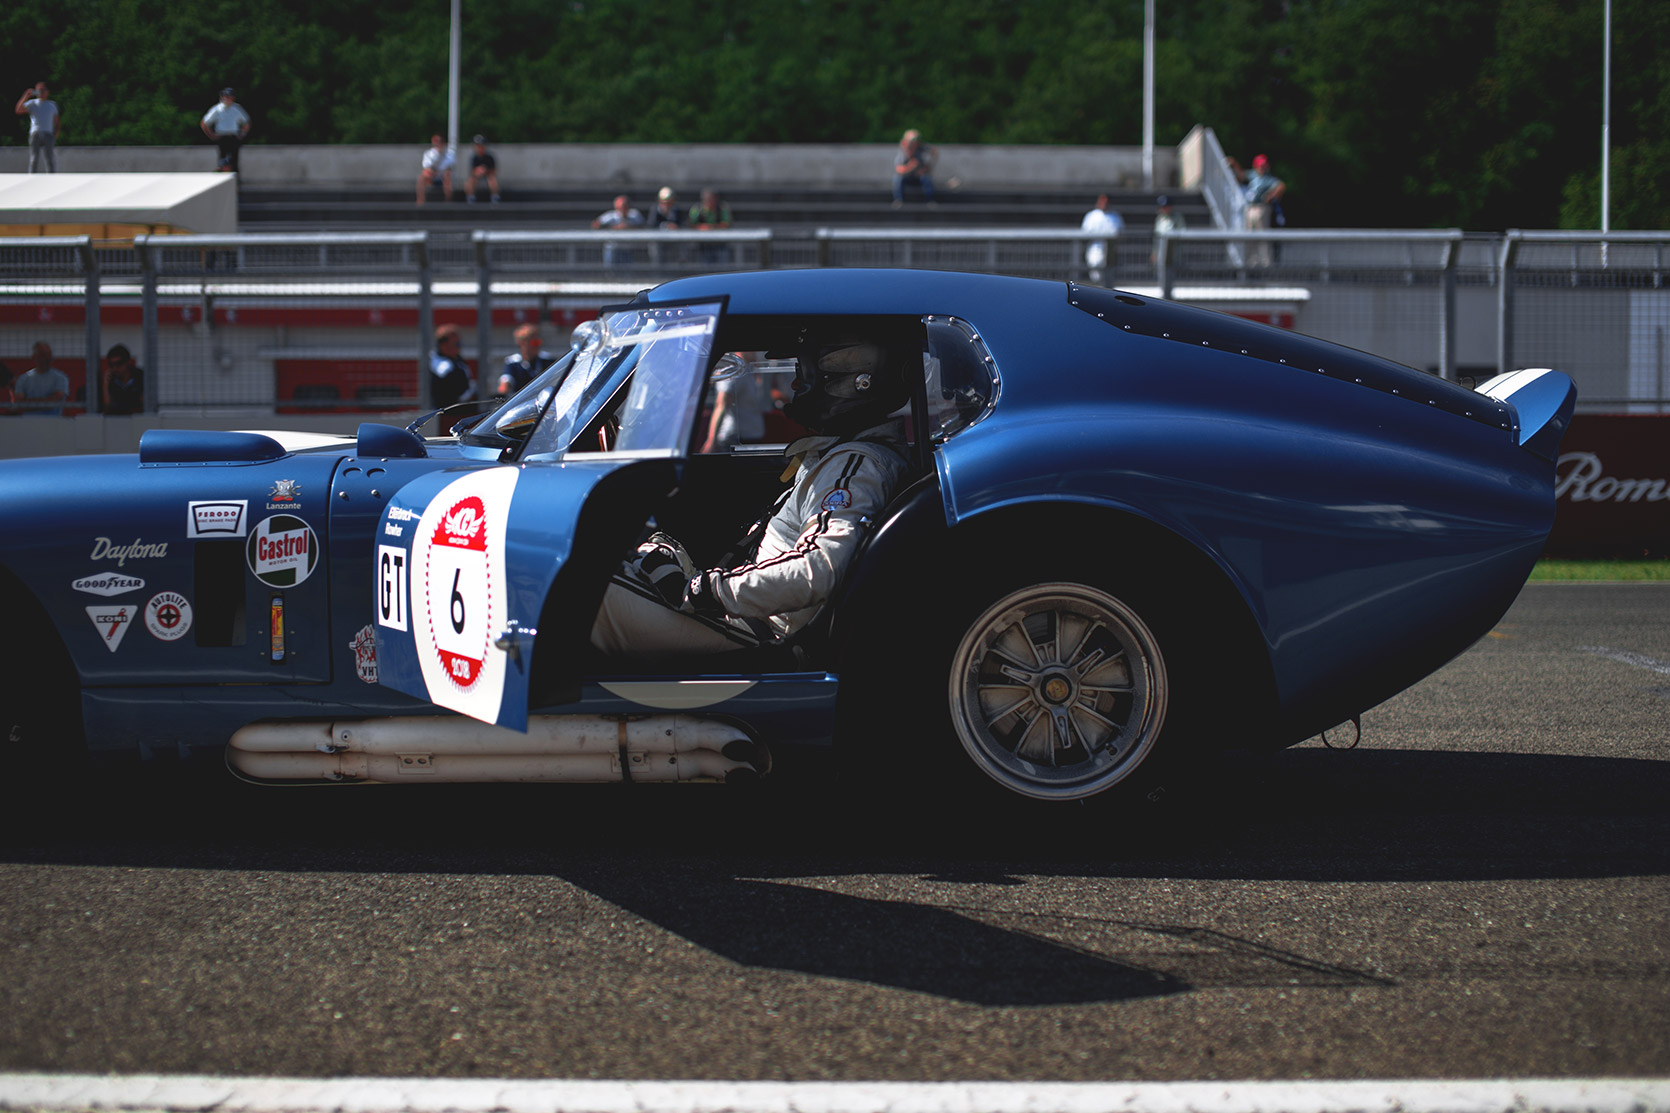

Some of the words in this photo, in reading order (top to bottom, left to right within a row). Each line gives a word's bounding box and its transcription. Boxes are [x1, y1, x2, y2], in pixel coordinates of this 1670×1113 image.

[90, 537, 169, 567] Daytona
[259, 529, 308, 562] Castrol
[76, 576, 142, 590] GOODYEAR
[381, 552, 403, 623] GT
[150, 594, 188, 611] AUTOLITE
[450, 568, 465, 635] 6
[97, 615, 128, 623] KONI
[451, 657, 470, 680] 2018
